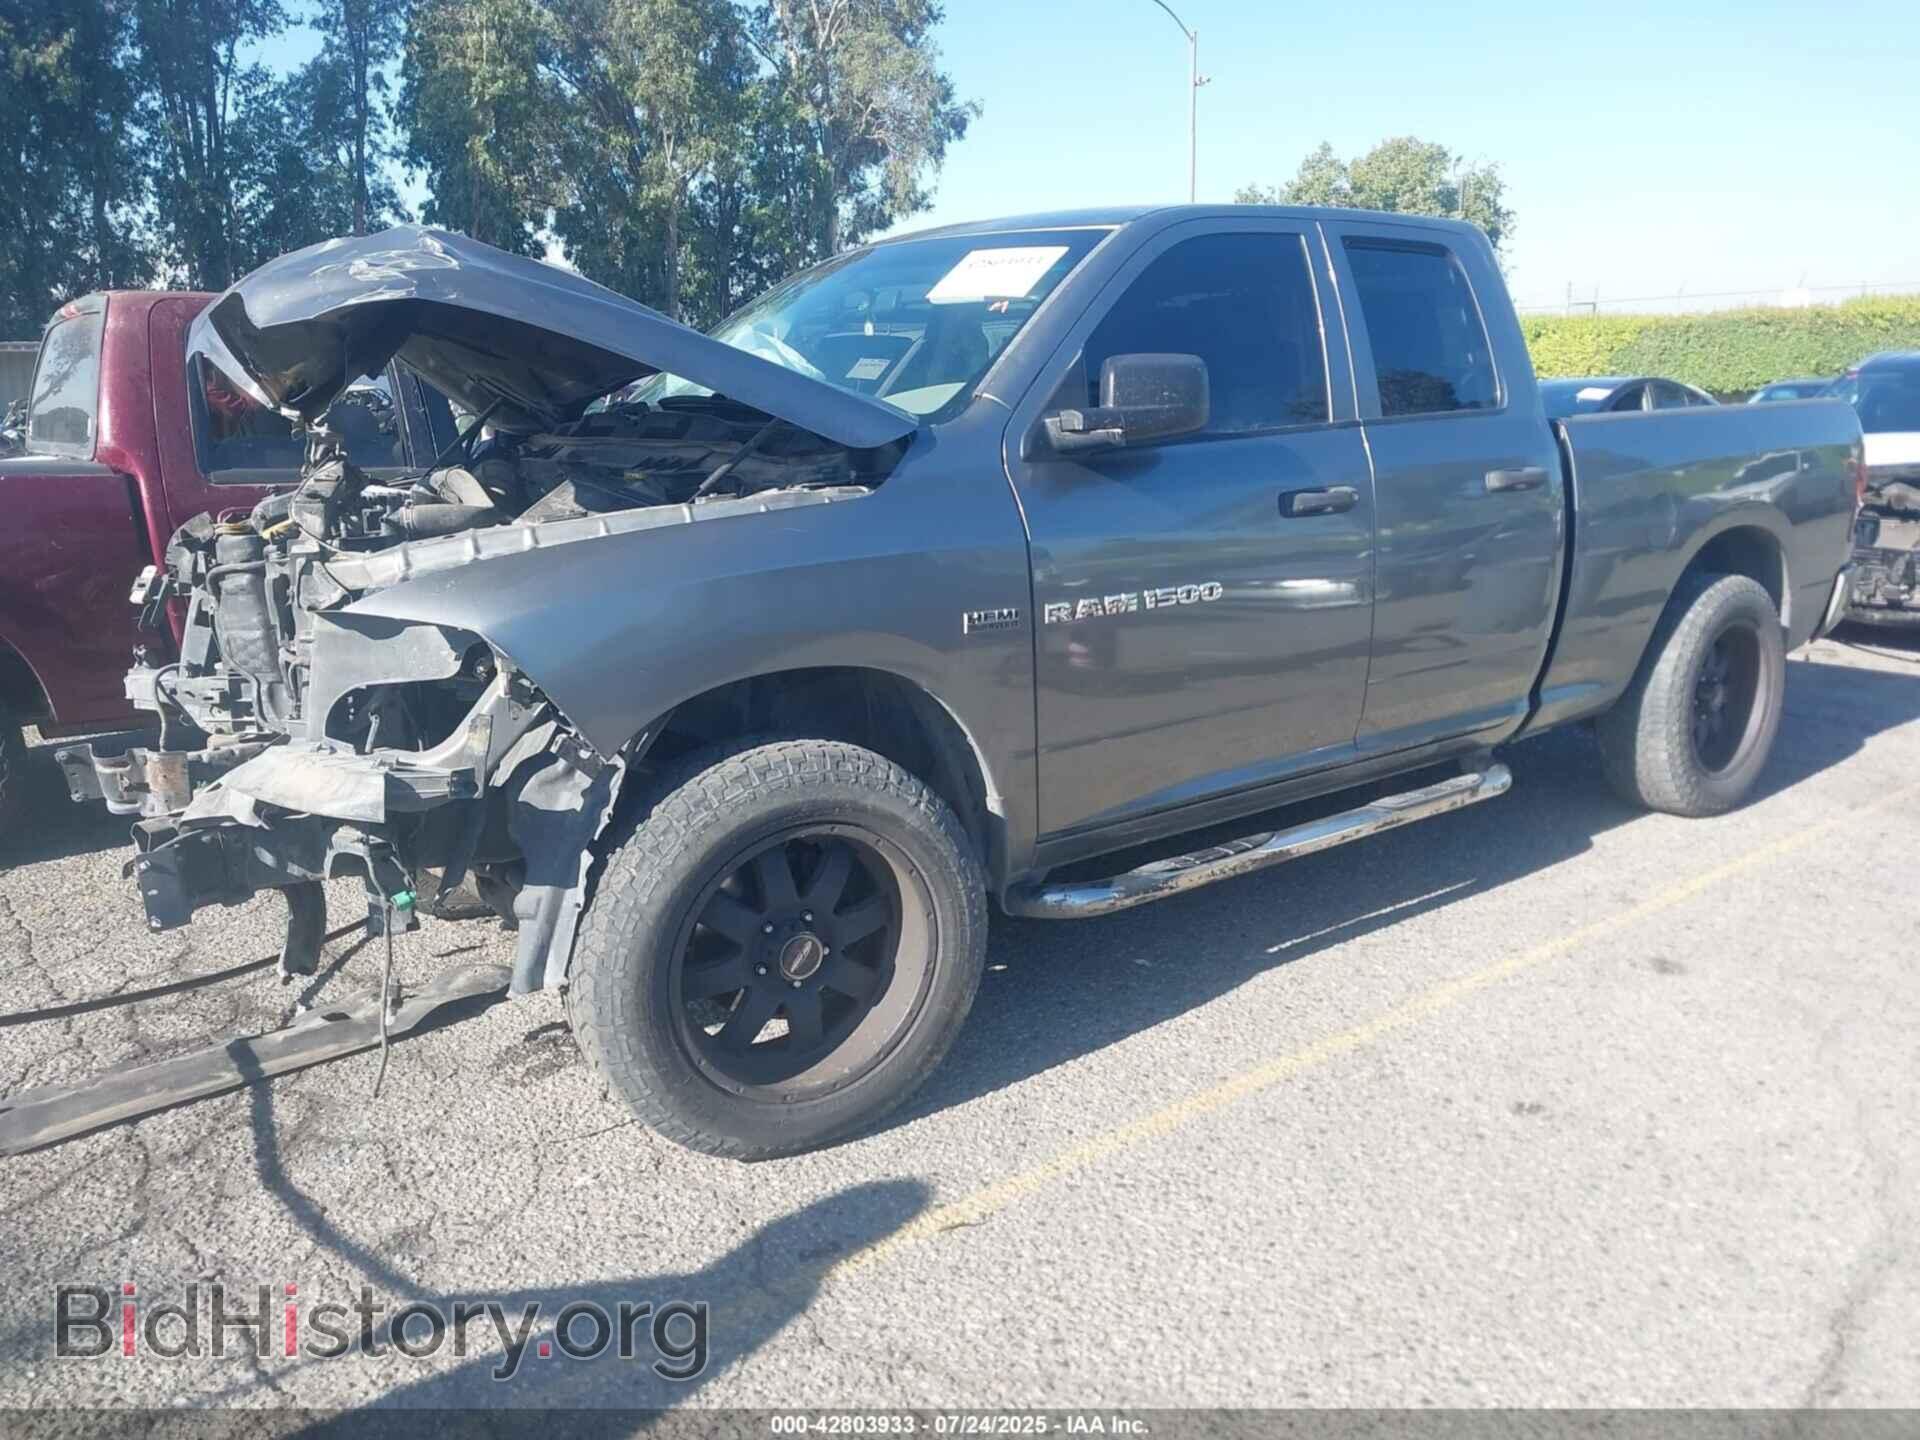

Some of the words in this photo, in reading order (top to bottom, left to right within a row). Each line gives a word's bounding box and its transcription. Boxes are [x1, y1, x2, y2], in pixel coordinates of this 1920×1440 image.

[1043, 592, 1139, 625] RAM
[1143, 581, 1224, 610] 1500
[962, 608, 1020, 635] HEMI
